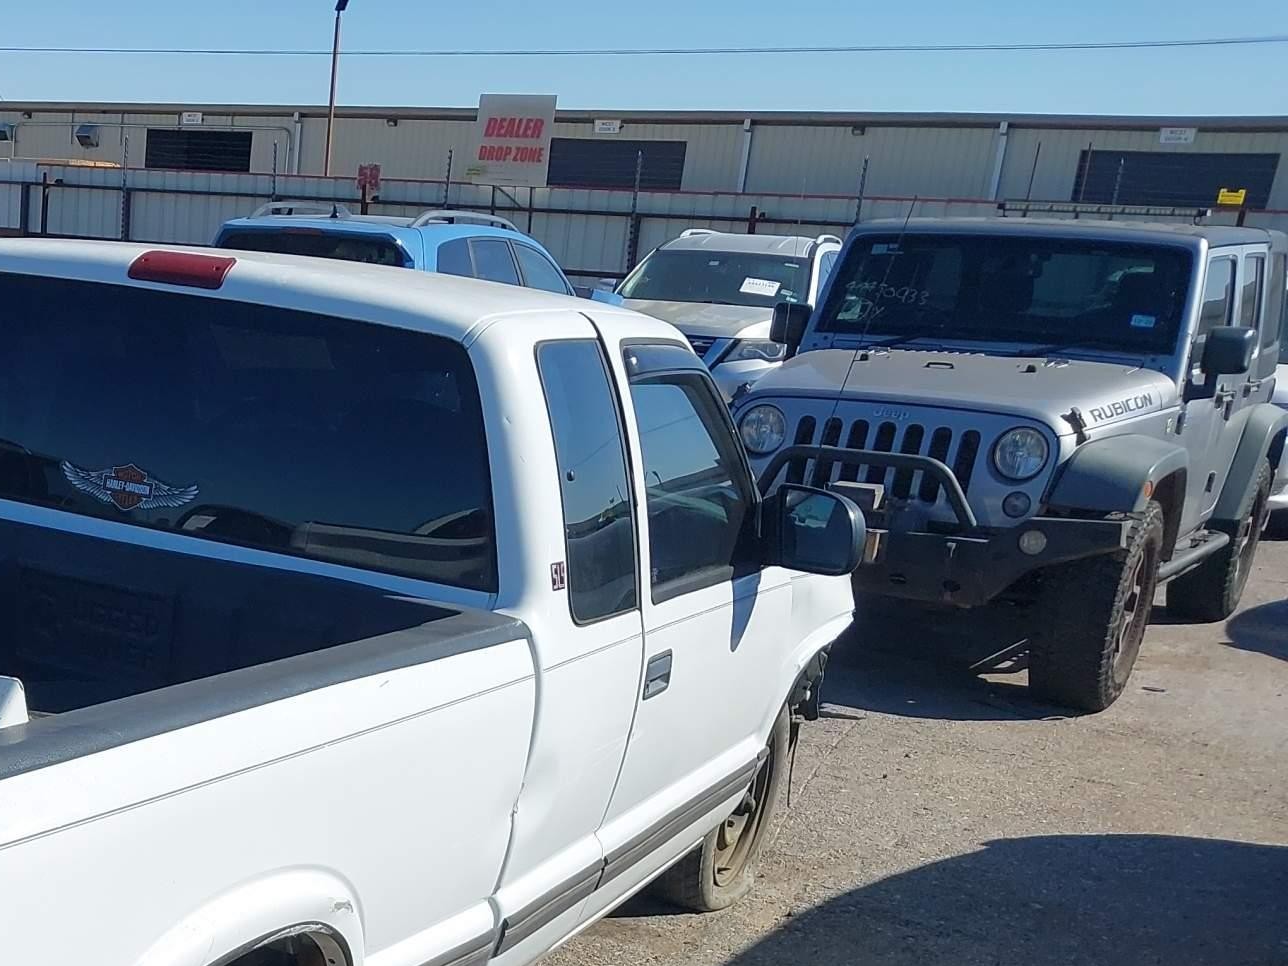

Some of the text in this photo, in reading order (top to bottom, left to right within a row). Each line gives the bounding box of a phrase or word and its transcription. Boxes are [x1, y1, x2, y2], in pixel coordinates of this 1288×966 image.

[484, 117, 545, 139] DEALER
[478, 145, 544, 163] DROP ZONE
[873, 406, 910, 420] Jeep
[1089, 393, 1153, 422] RUBICON
